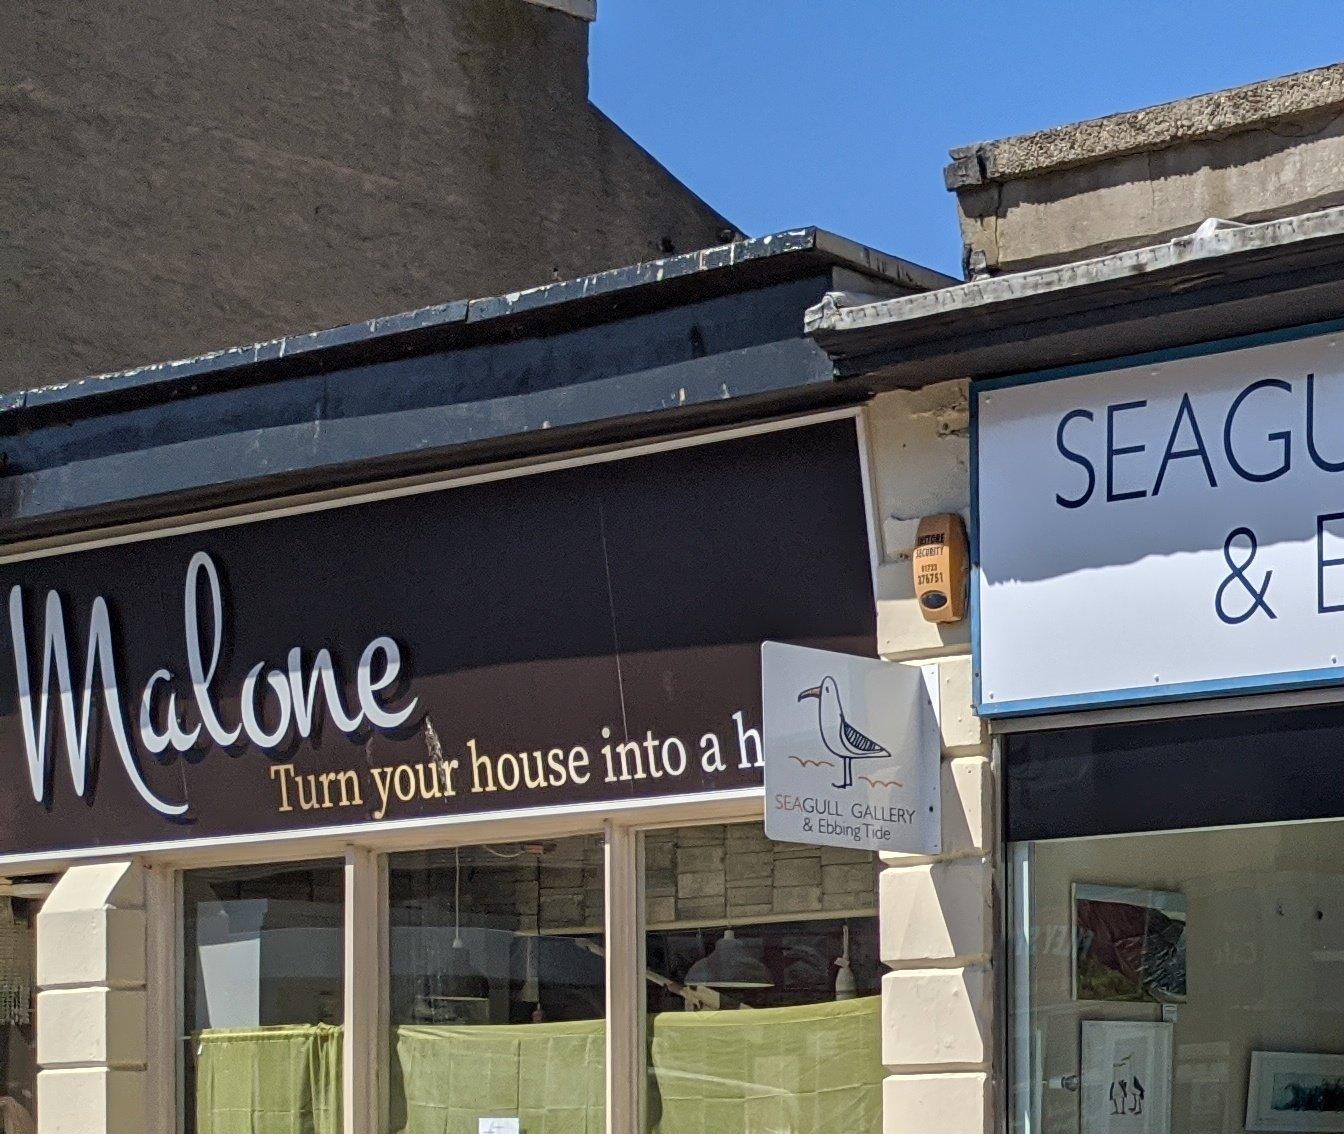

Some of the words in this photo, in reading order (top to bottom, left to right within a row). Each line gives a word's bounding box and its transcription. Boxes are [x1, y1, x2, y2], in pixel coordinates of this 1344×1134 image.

[1215, 527, 1276, 624] &
[9, 551, 418, 815] Malone
[270, 762, 364, 812] Turn
[370, 759, 459, 820] your
[466, 738, 591, 793] house
[600, 727, 687, 783] into
[699, 733, 727, 773] a
[775, 794, 843, 817] SEAGULL
[851, 803, 916, 825] GALLERY
[802, 817, 814, 832] &
[818, 819, 861, 841] Ebbing
[865, 823, 891, 841] Tide
